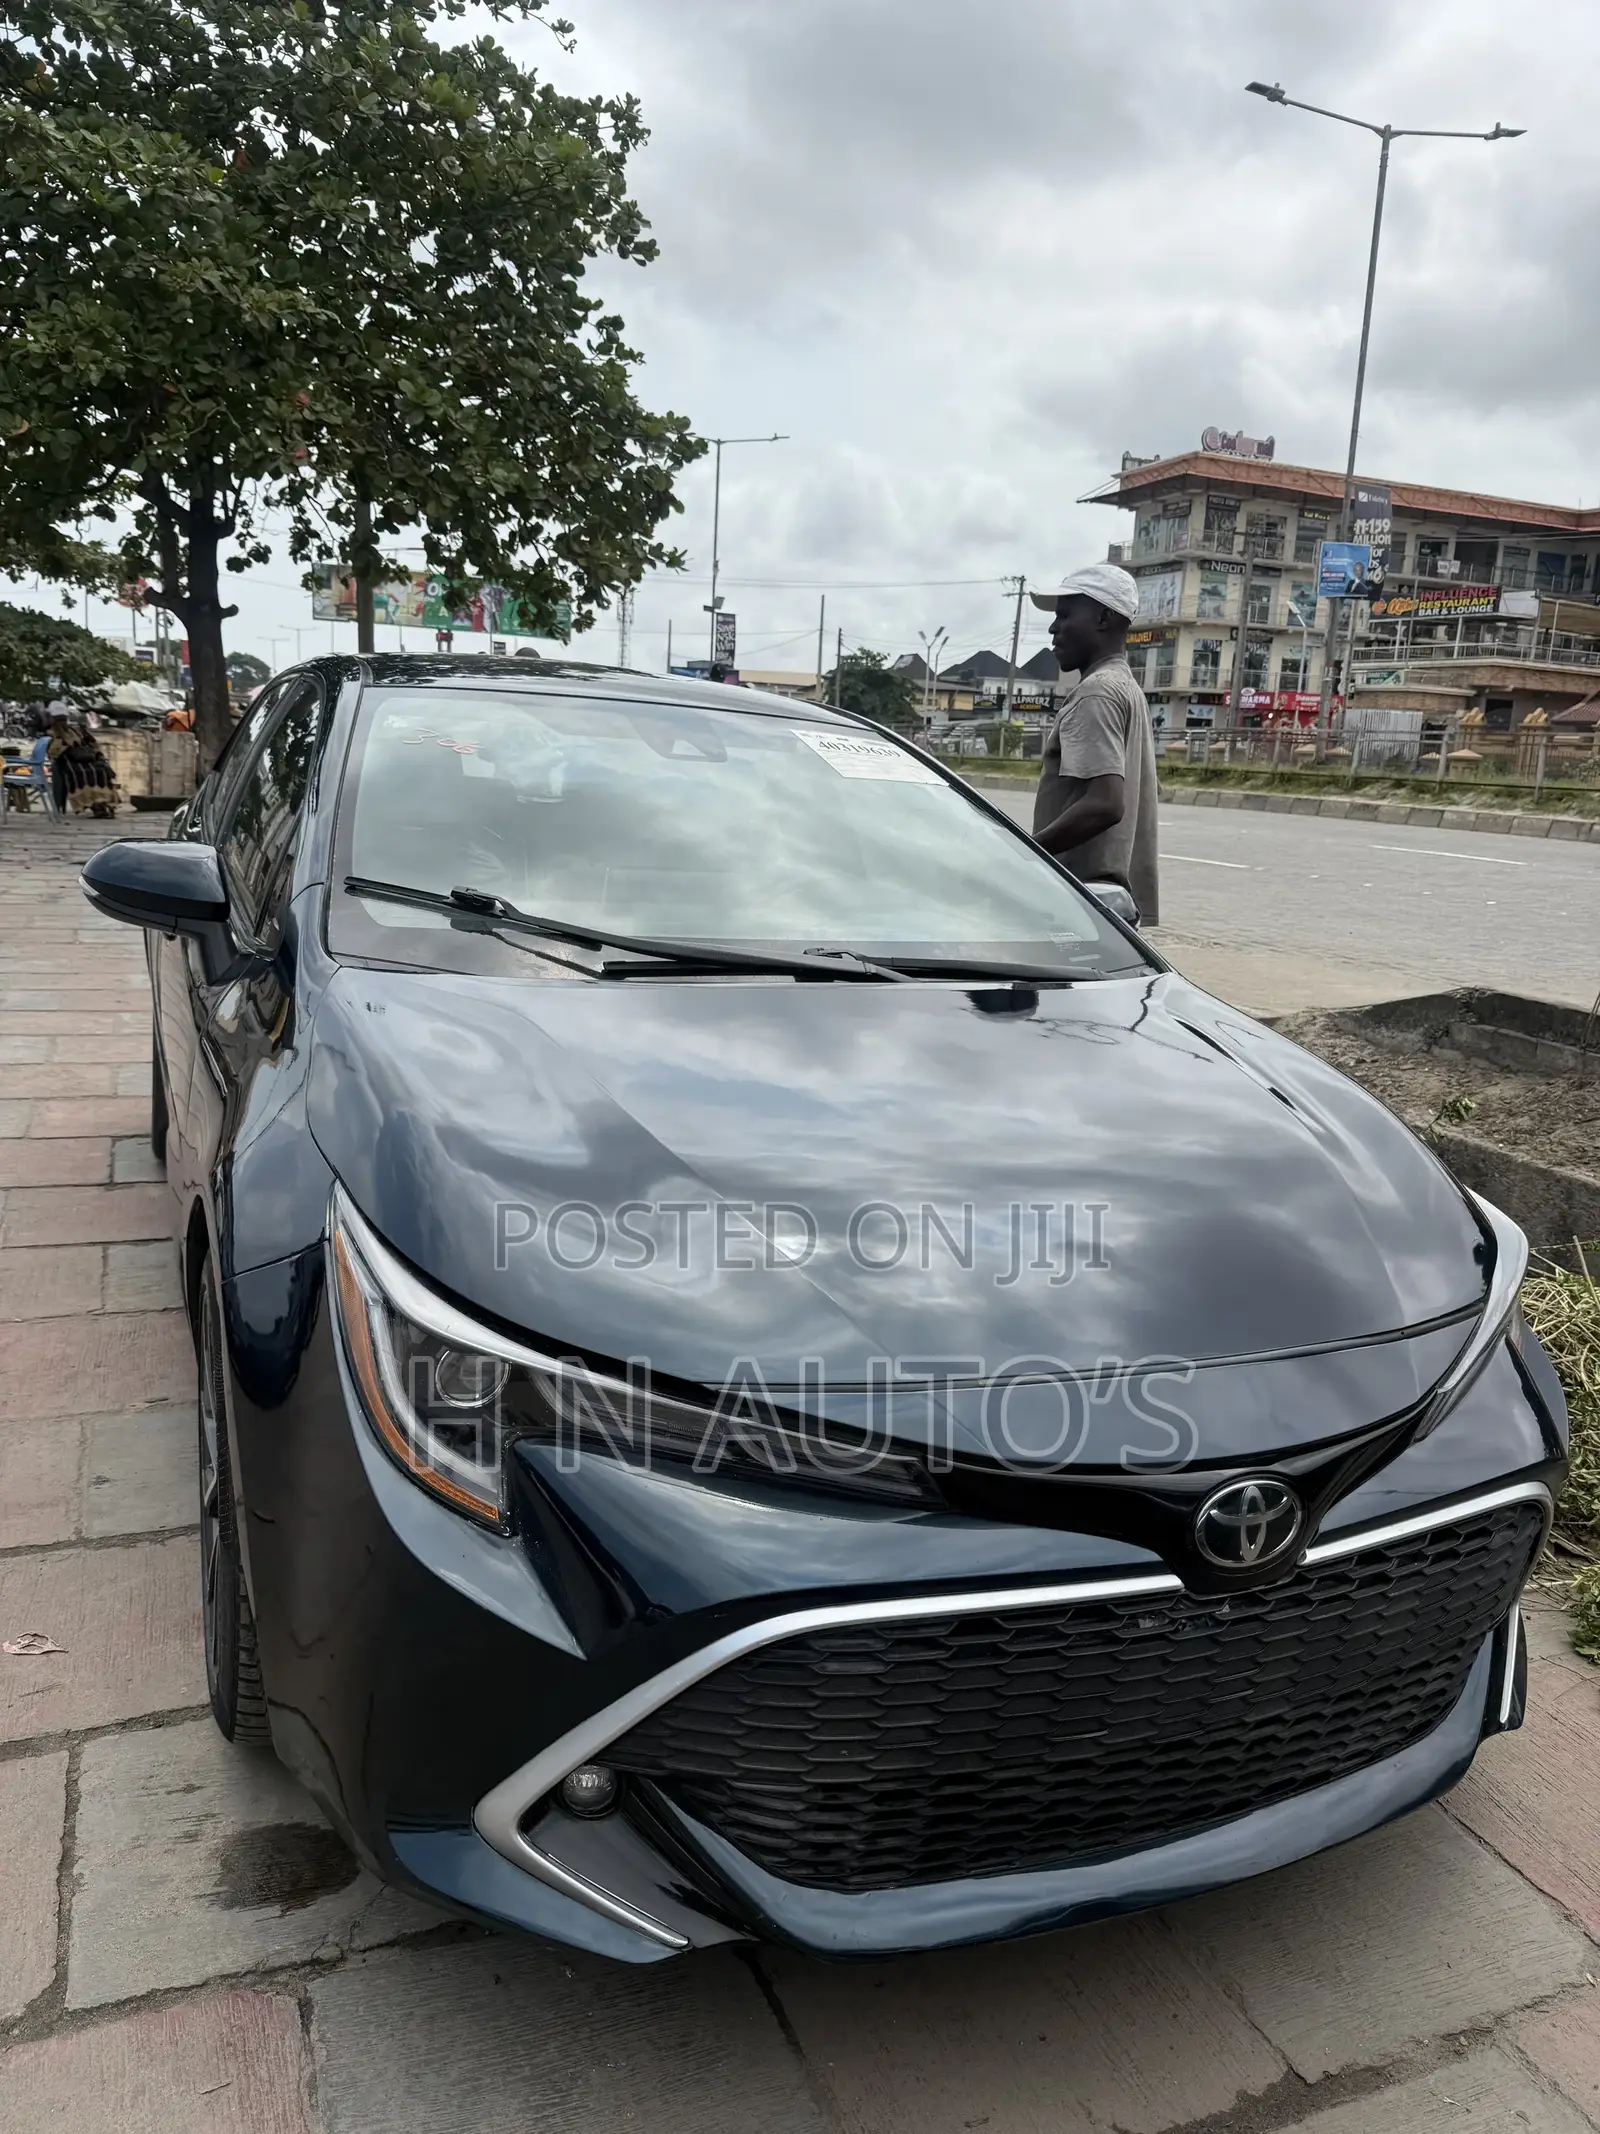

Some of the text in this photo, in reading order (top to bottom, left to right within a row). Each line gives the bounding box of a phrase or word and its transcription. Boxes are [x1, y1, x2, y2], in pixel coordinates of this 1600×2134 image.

[1352, 534, 1392, 545] MILLION
[1210, 560, 1246, 575] Neon
[1419, 586, 1497, 602] INFLUENCE
[1418, 596, 1497, 609] RESTAURANT
[1418, 604, 1494, 616] BAR & LOUNGE
